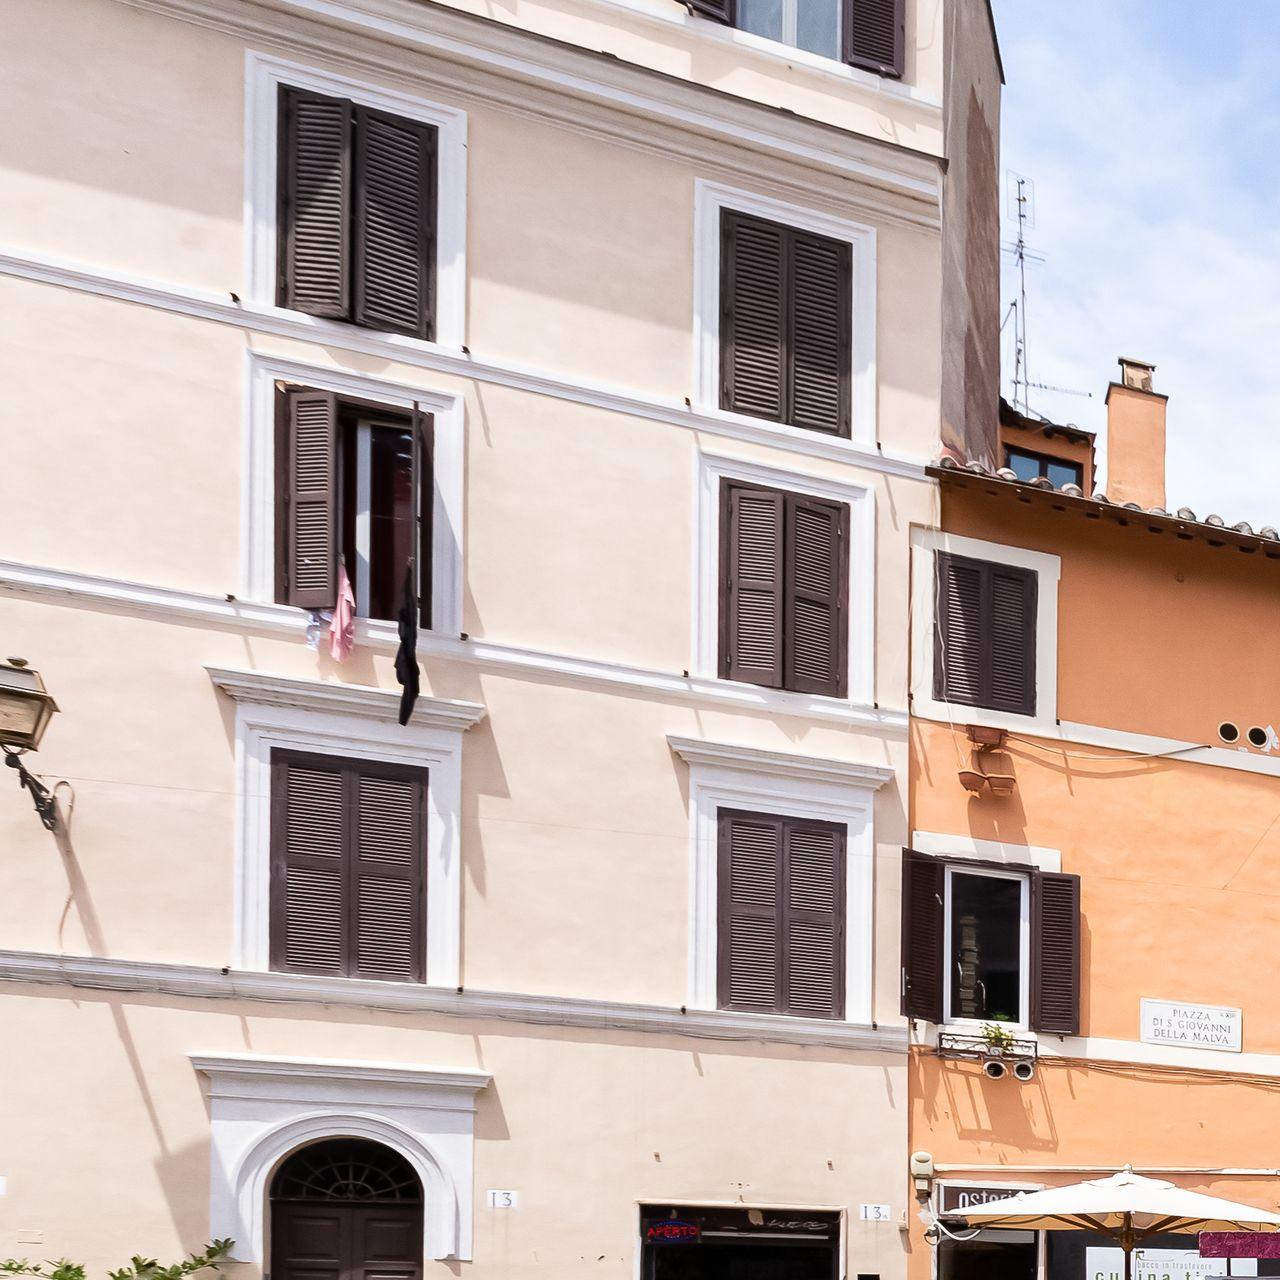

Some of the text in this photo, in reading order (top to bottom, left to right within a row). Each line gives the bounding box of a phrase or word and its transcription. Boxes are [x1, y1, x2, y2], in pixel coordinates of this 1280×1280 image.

[1172, 1009, 1211, 1021] PIAZZA
[1152, 1017, 1163, 1027] DI
[1178, 1020, 1231, 1034] GIOVANNI
[1153, 1029, 1229, 1044] DELLA MALVA
[492, 1191, 512, 1208] 13
[647, 1226, 698, 1237] APERTO
